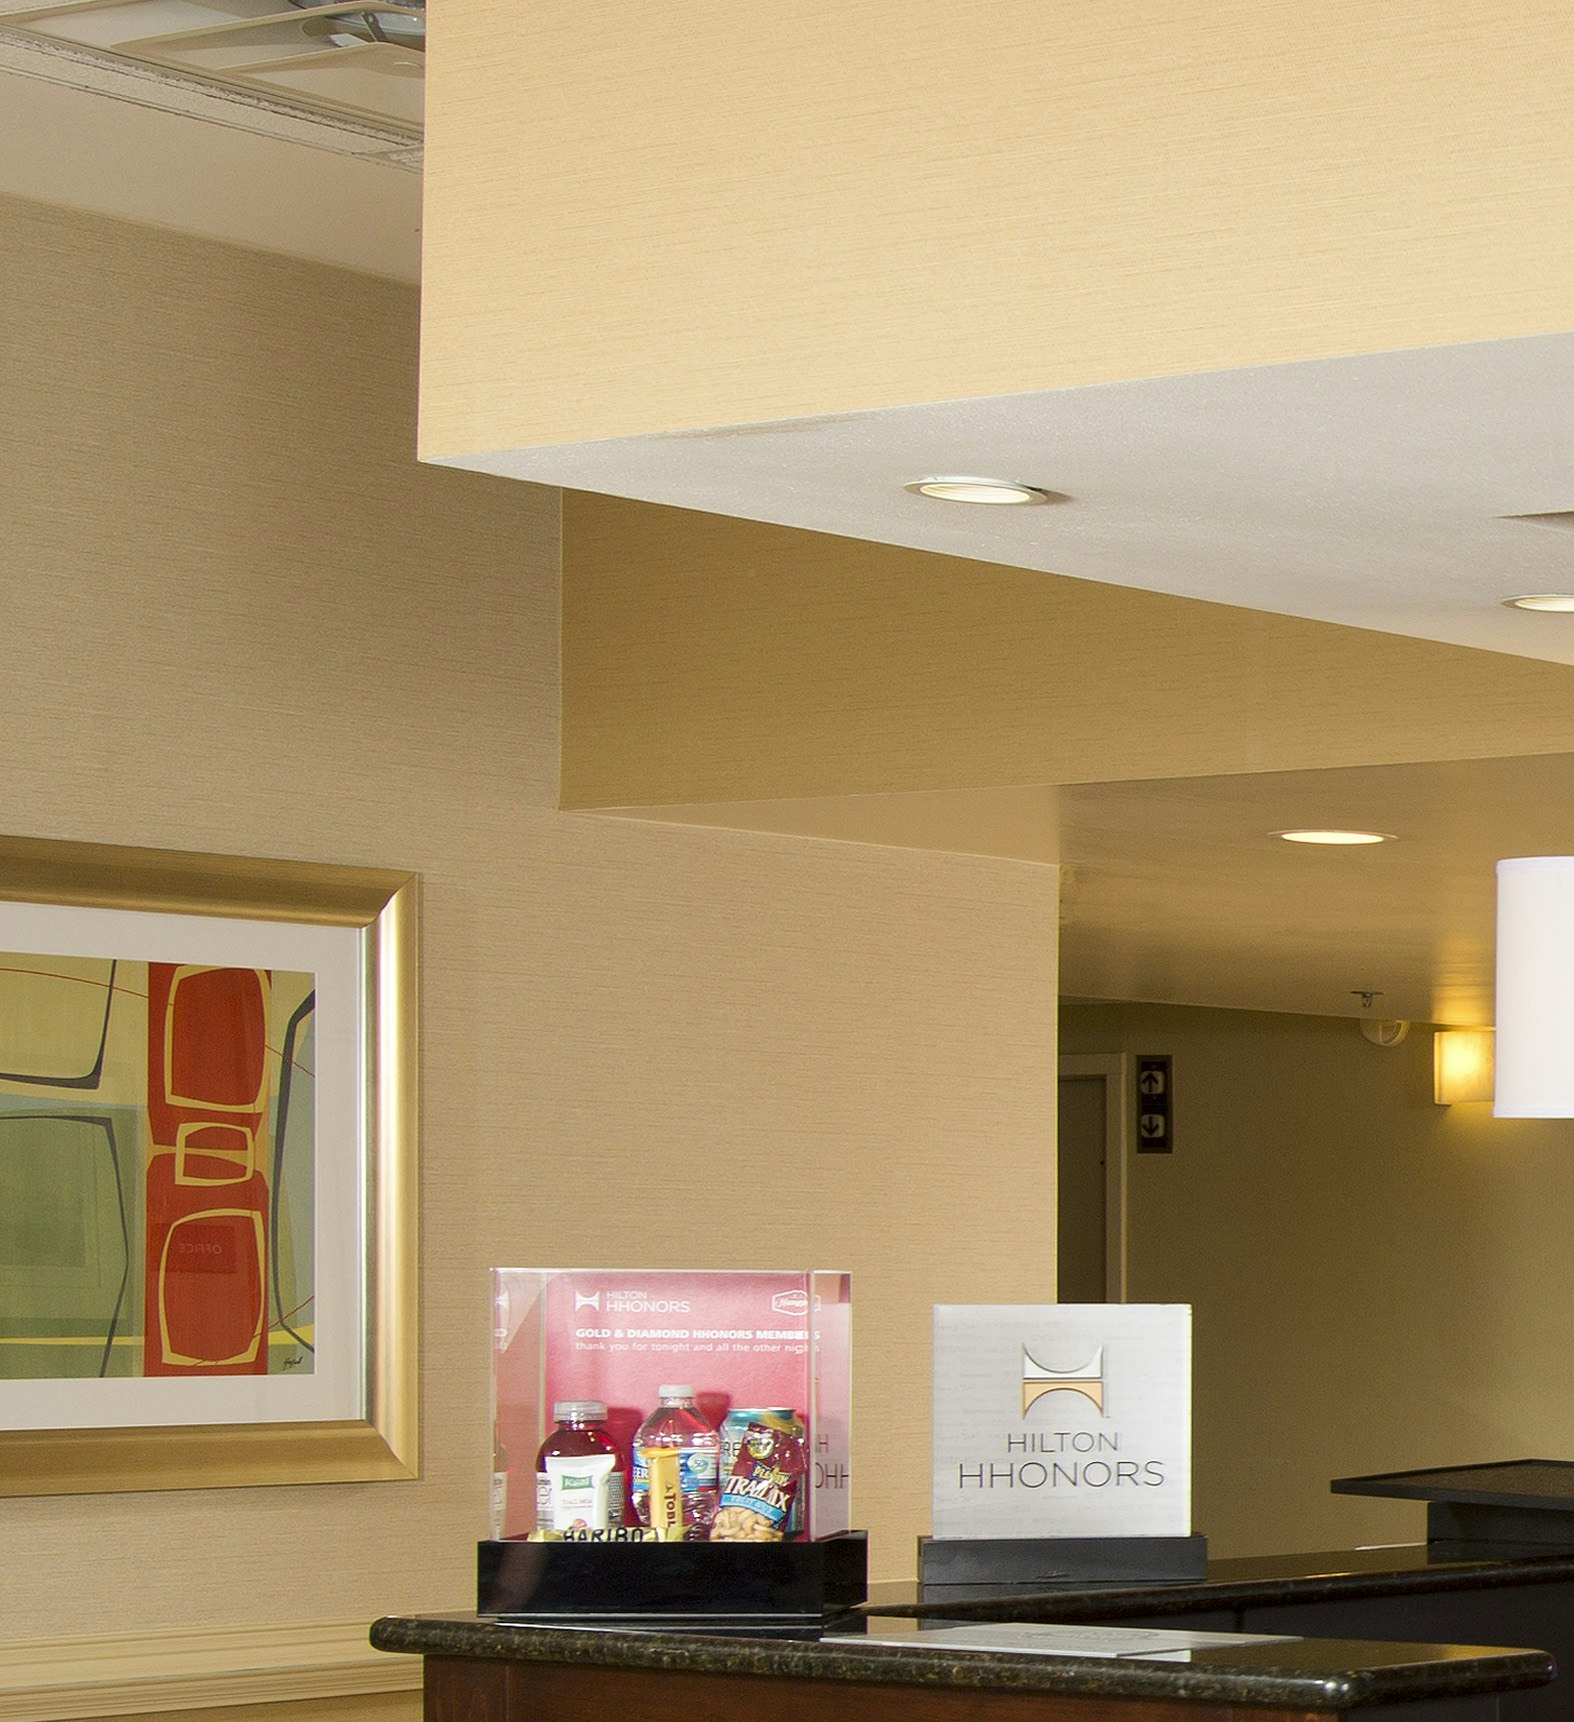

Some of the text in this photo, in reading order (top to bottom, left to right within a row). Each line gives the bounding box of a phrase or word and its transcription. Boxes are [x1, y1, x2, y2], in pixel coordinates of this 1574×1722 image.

[606, 1290, 648, 1299] HILTON
[606, 1300, 690, 1313] HHONORS
[575, 1328, 820, 1340] GOLD & DIAMOND HHONORS MEMBES
[575, 1342, 606, 1351] thank
[609, 1343, 629, 1352] you
[632, 1342, 647, 1351] for
[651, 1342, 690, 1353] tonight
[693, 1343, 713, 1352] and
[715, 1343, 729, 1352] all
[732, 1343, 750, 1352] the
[752, 1343, 781, 1352] other
[1007, 1431, 1118, 1452] HILTON
[958, 1460, 1165, 1488] HHONORS
[562, 1528, 644, 1541] HARIBO
